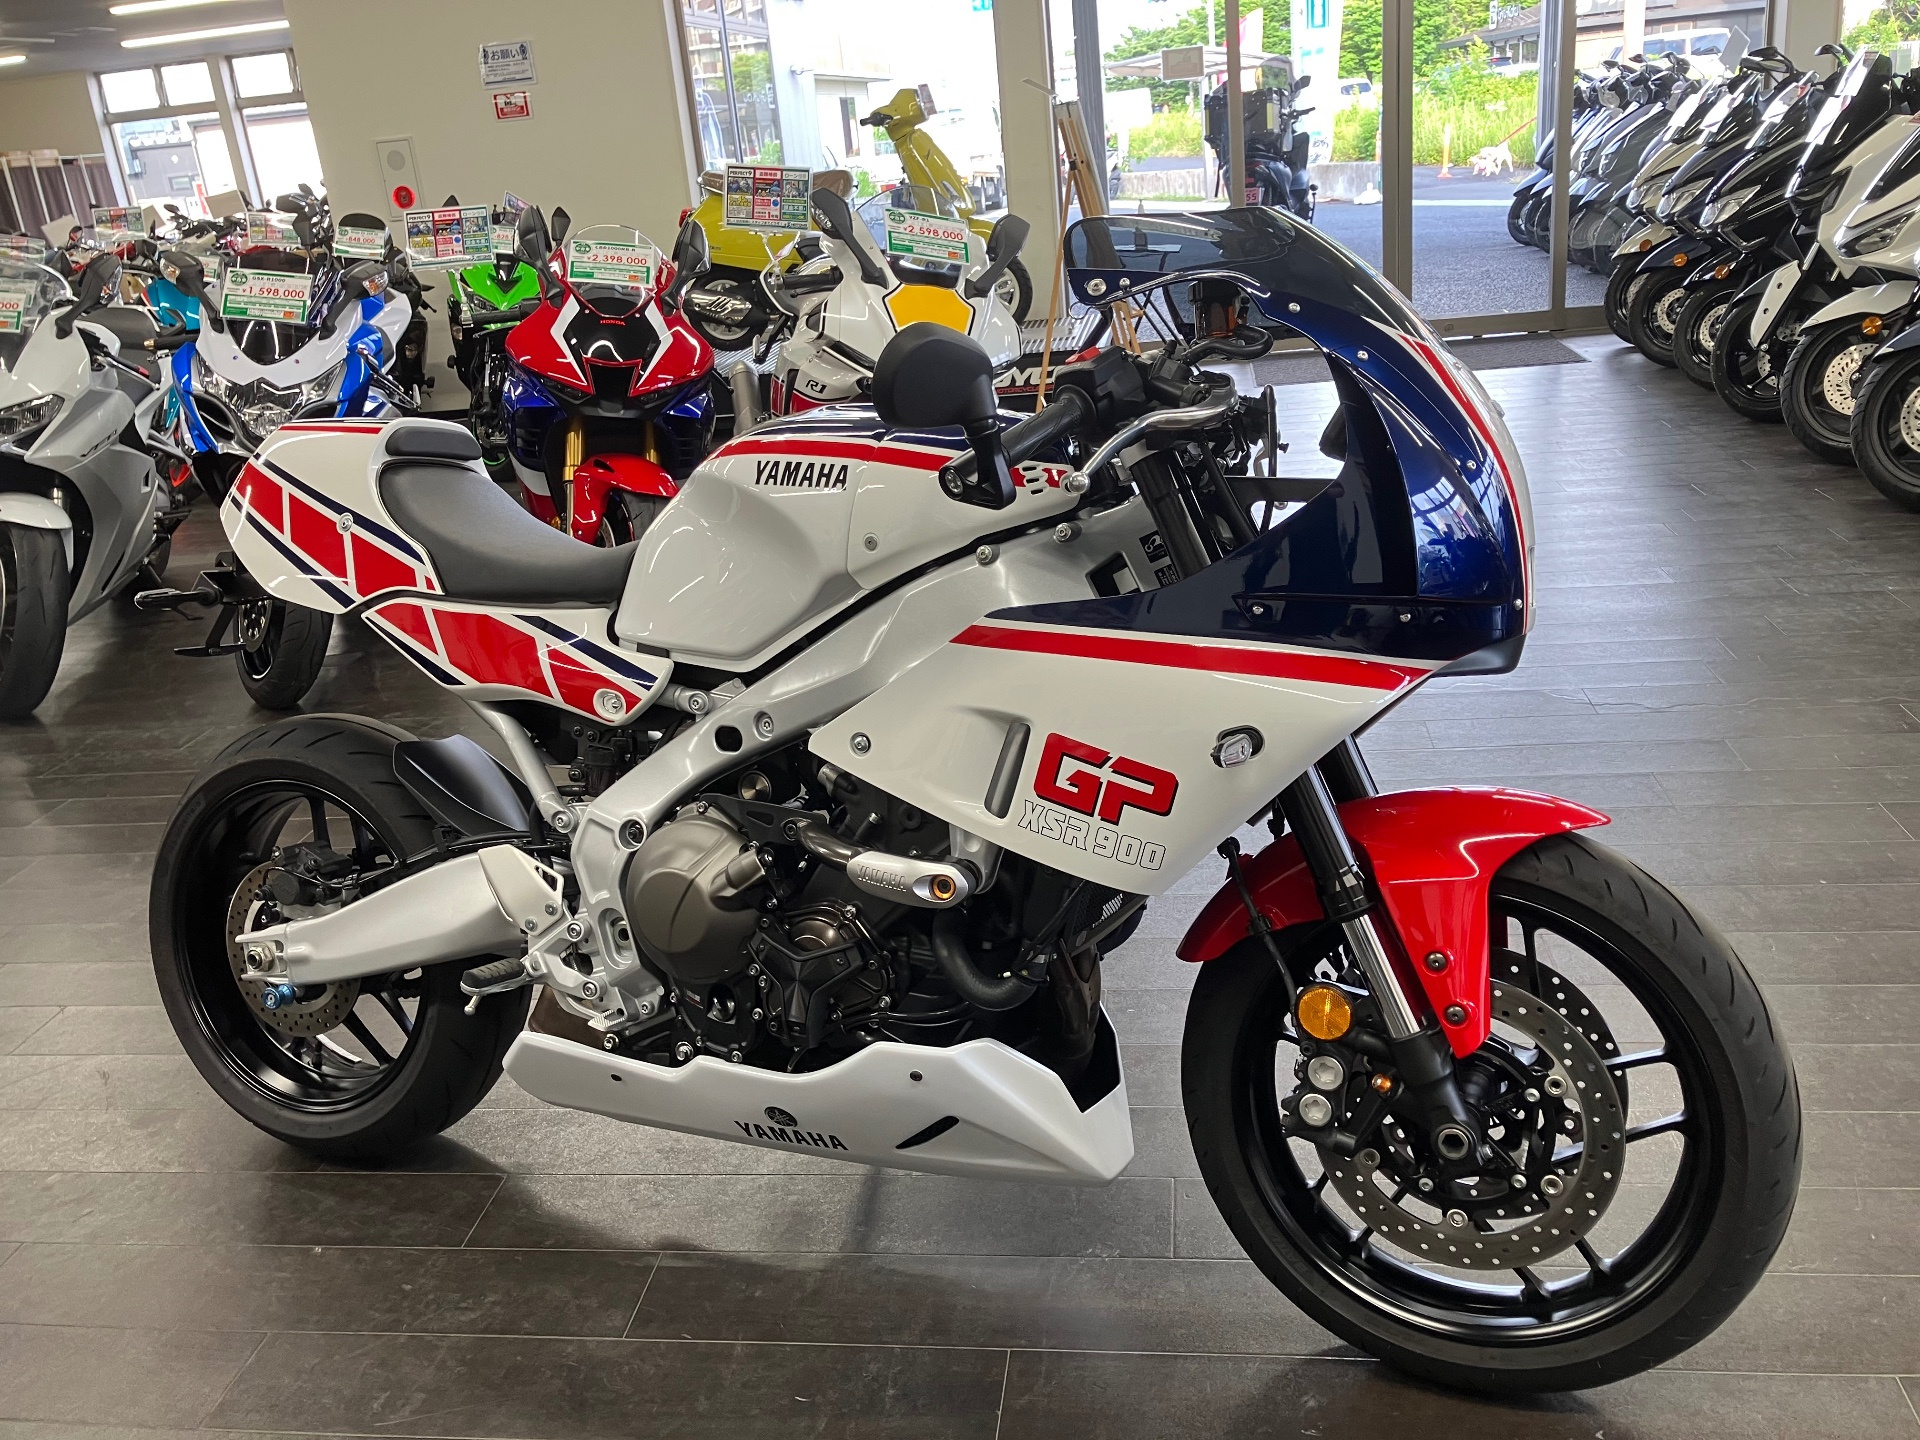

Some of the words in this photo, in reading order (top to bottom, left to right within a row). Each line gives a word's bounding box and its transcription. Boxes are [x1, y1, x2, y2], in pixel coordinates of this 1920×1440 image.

[490, 48, 520, 61] お願い
[903, 225, 964, 241] ¥2,598,000
[586, 254, 647, 266] ¥2,398,000
[242, 286, 305, 299] ¥1,598,000
[805, 379, 828, 395] R1
[755, 460, 849, 491] YAMAHA
[1033, 732, 1180, 827] GP
[857, 864, 907, 892] YAMAHA
[733, 1120, 850, 1152] YAMAHA
